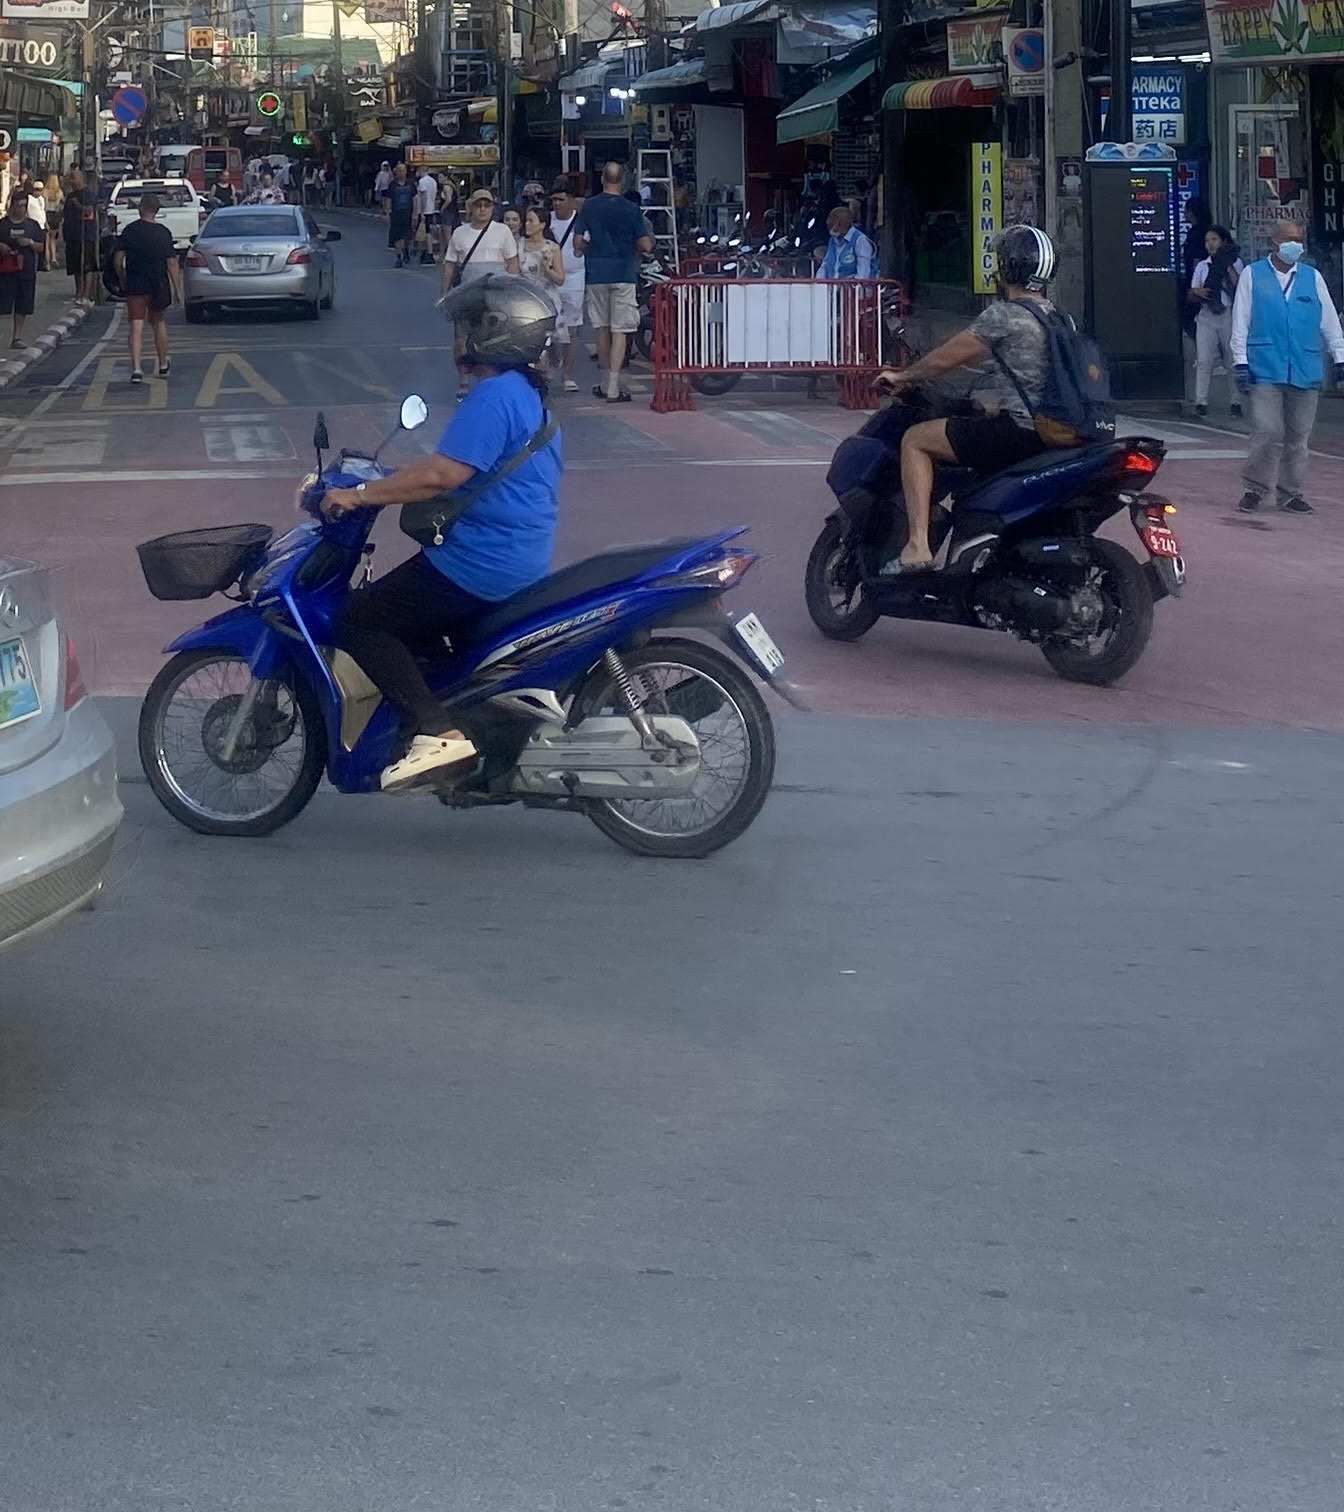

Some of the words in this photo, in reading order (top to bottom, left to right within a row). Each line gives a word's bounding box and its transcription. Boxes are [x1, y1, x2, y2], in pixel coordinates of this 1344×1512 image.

[1219, 0, 1273, 47] HAPPY
[1136, 119, 1179, 139] 药店
[980, 143, 994, 288] PHARMACY
